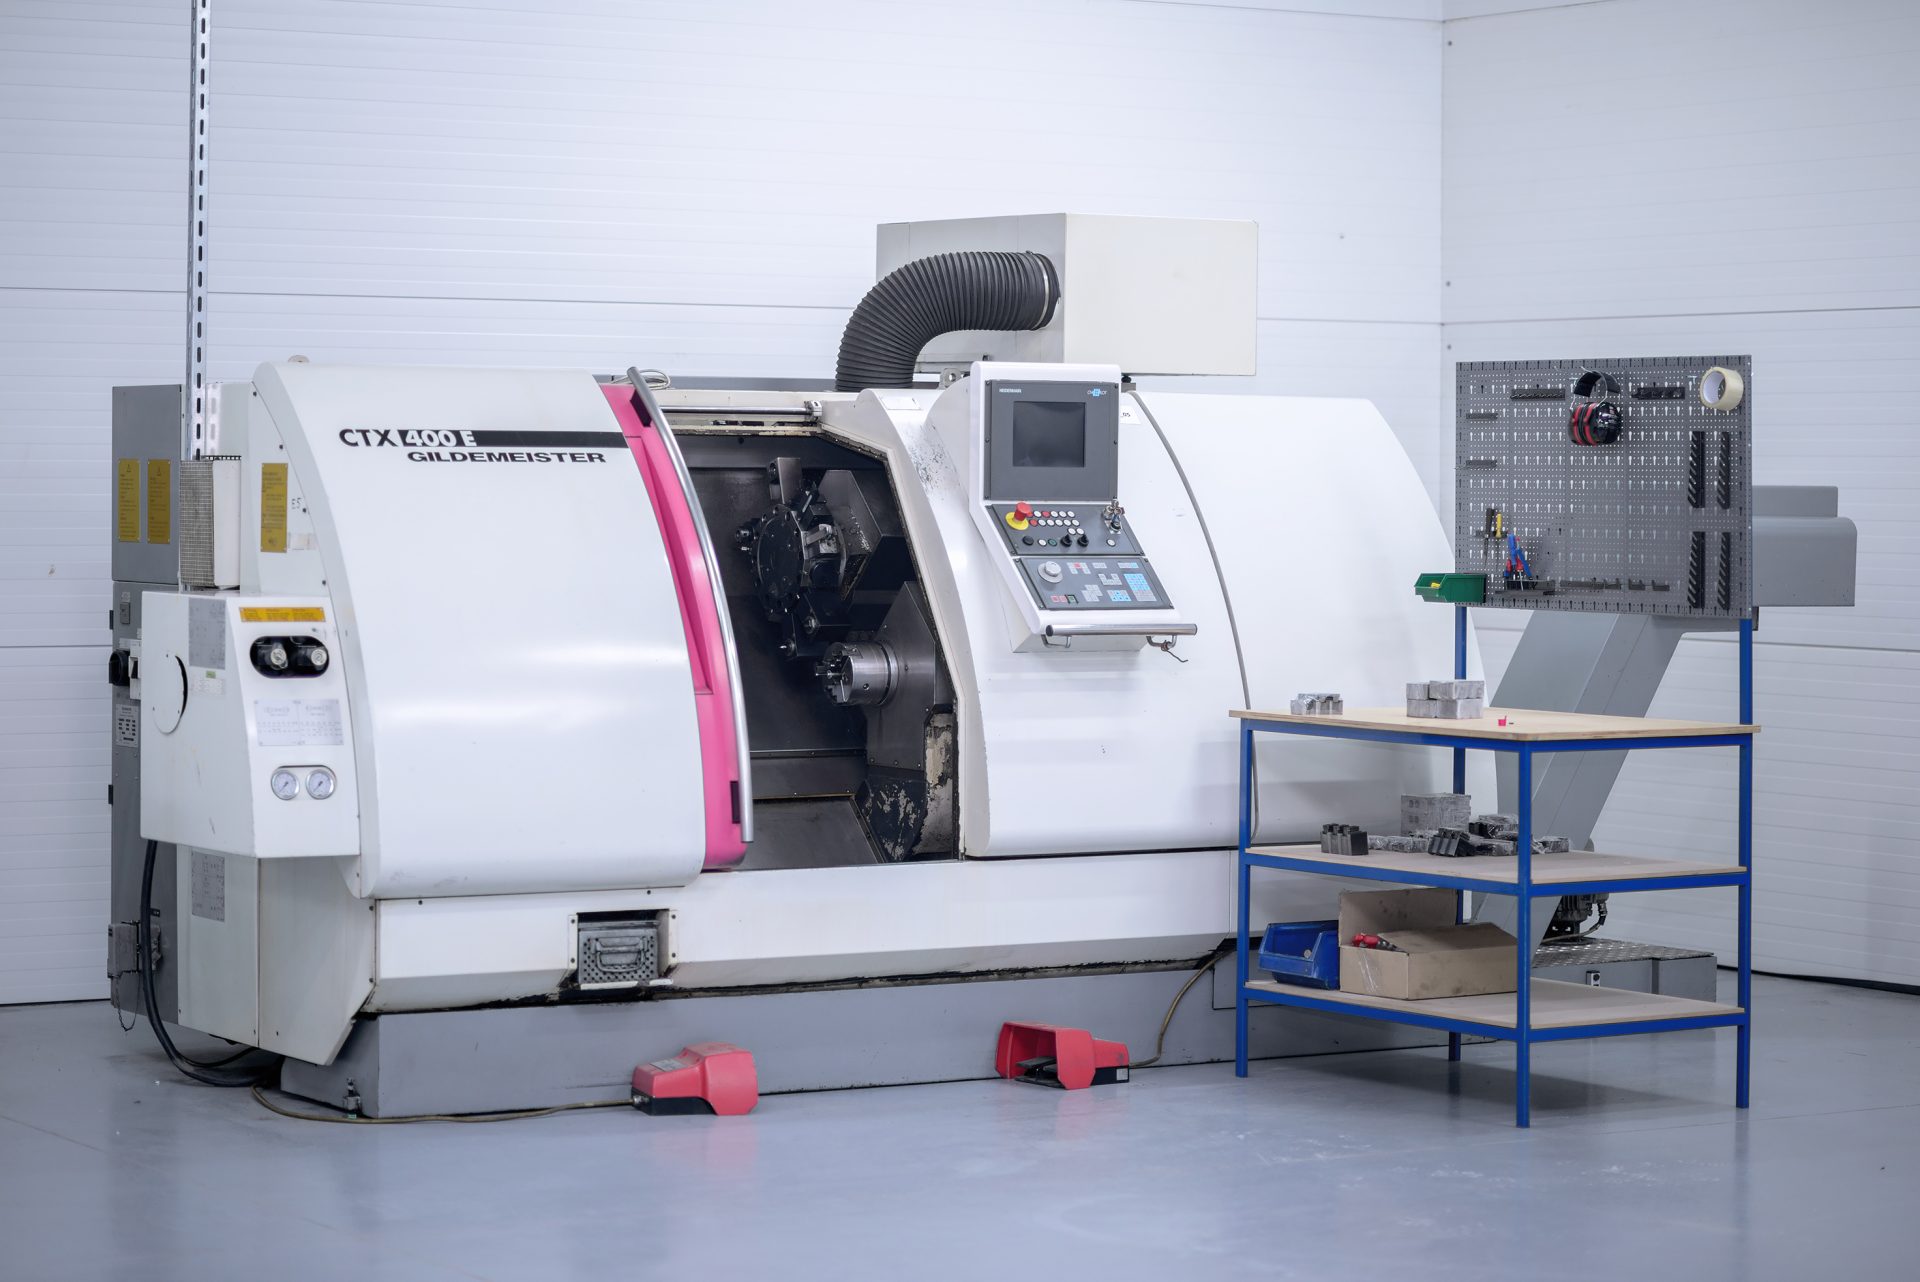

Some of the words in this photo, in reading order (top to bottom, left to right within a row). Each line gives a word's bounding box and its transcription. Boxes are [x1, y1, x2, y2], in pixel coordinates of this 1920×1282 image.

[339, 429, 398, 447] CTX
[404, 430, 457, 447] 400
[459, 431, 477, 447] E
[407, 451, 607, 463] GILDEMEISTER
